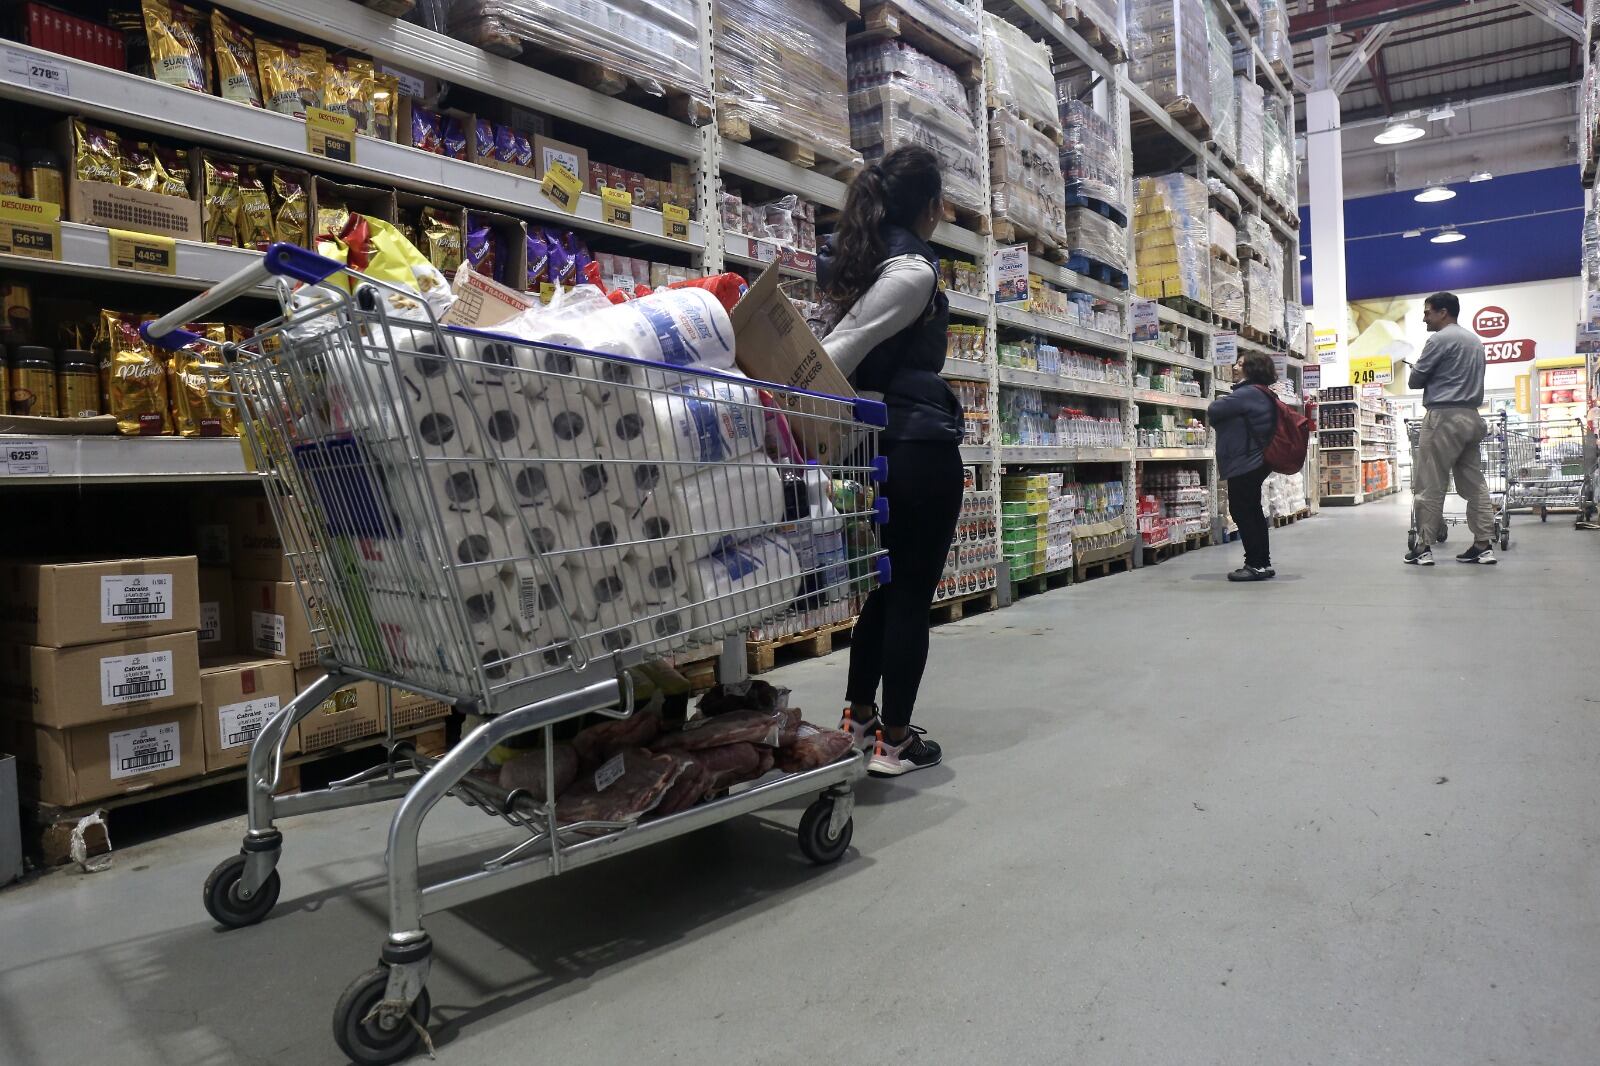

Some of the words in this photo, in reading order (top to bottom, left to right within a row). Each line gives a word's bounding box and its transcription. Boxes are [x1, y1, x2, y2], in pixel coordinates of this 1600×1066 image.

[164, 56, 190, 68] SUAV
[1, 201, 43, 214] DESCUENTO
[1482, 342, 1523, 361] ESOS
[124, 664, 149, 673] Cabrales
